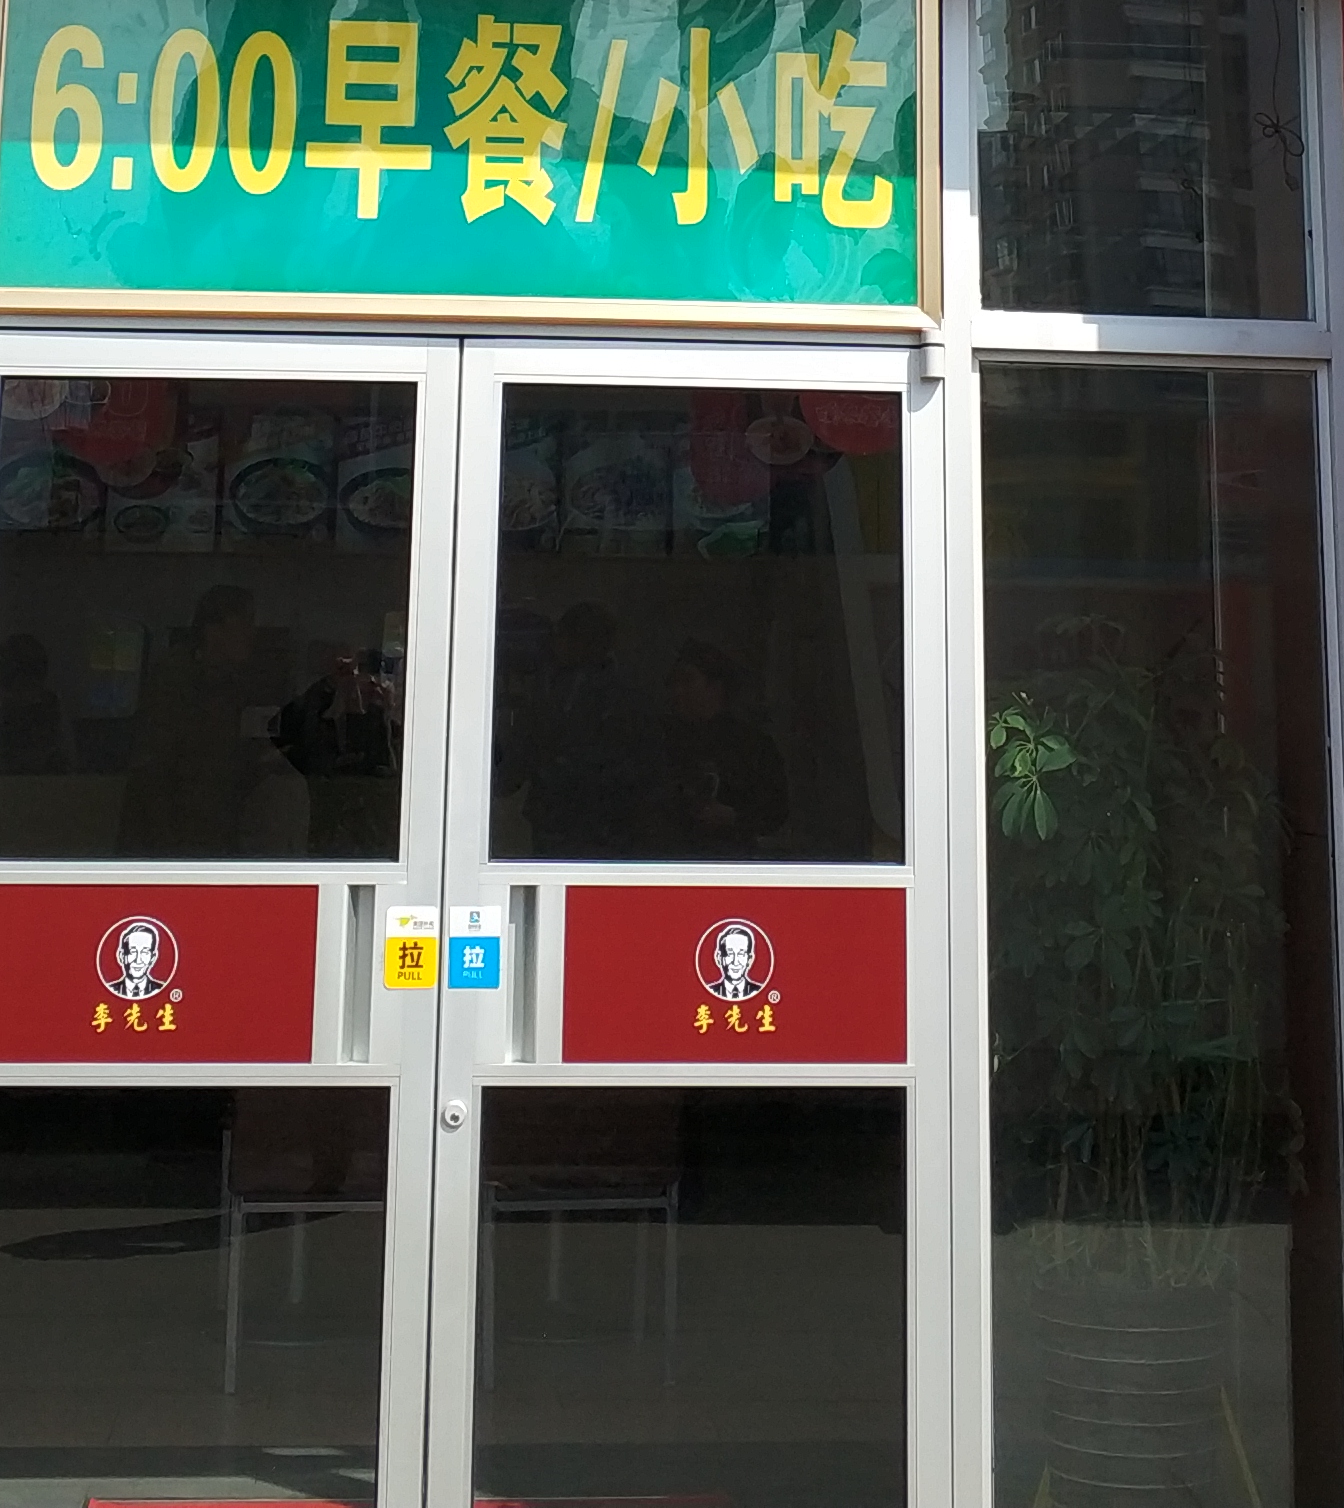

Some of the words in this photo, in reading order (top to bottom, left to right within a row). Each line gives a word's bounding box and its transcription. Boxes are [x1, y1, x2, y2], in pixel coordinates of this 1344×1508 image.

[30, 14, 893, 229] 6:00早餐/小吃
[398, 941, 424, 970] 拉
[462, 945, 485, 969] 拉
[397, 971, 423, 981] PULL
[91, 1003, 177, 1033] 李先生
[693, 1004, 776, 1034] 李先生
